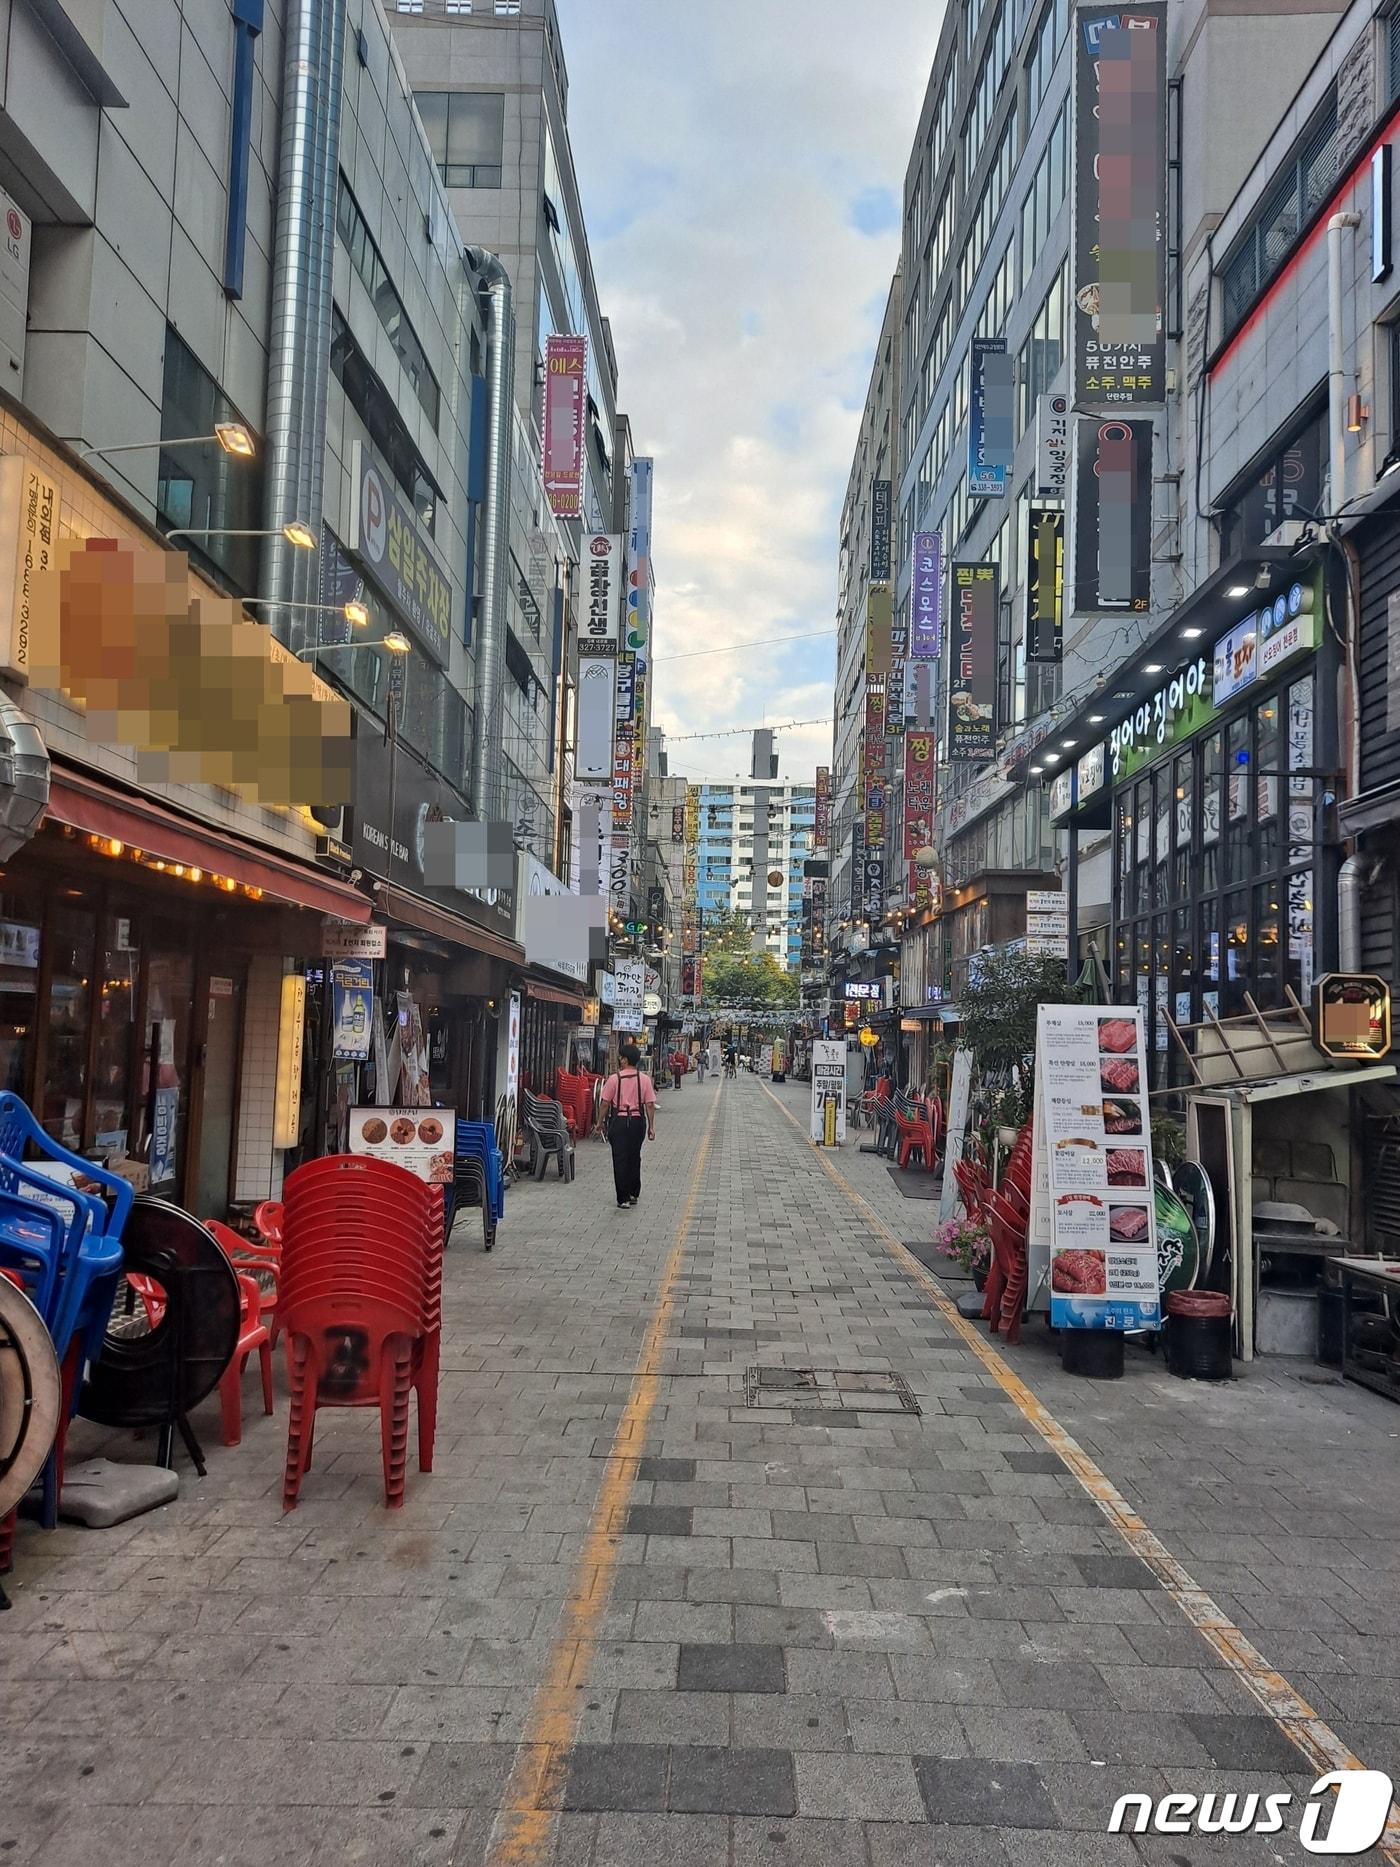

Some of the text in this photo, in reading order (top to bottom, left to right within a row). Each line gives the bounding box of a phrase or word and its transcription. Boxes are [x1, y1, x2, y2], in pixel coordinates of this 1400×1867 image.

[8, 237, 20, 260] LG
[1085, 355, 1153, 370] 퓨전안주
[388, 504, 450, 639] 삼일주차장
[918, 556, 935, 631] 코스모스
[1134, 599, 1148, 610] 2F
[911, 737, 933, 763] 짱
[907, 780, 932, 796] 노래
[362, 821, 386, 850] KOREAN
[615, 971, 643, 985] 까만
